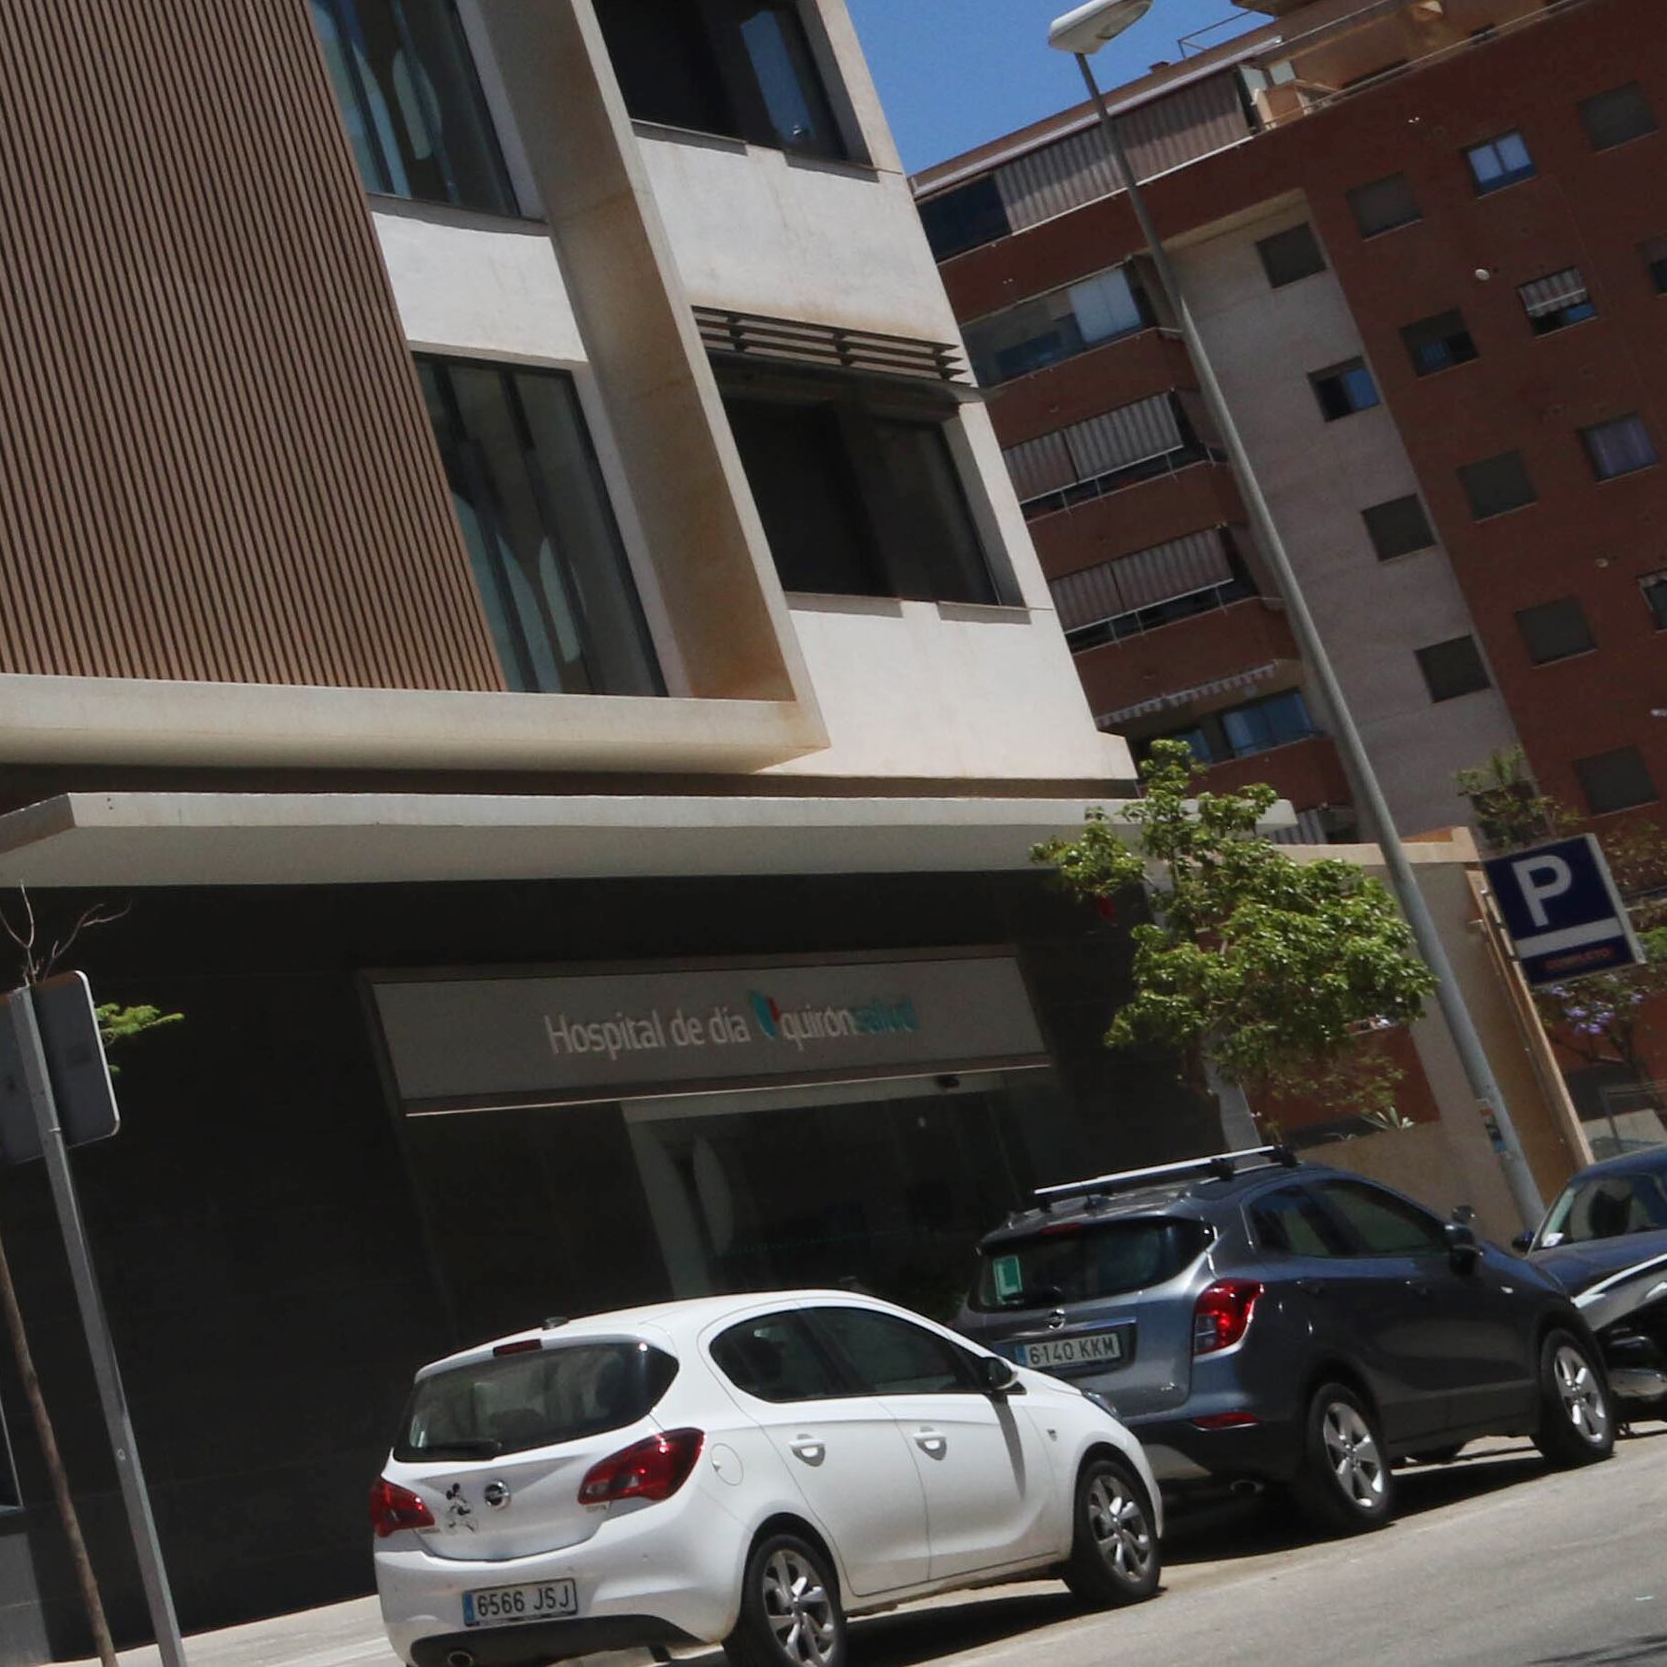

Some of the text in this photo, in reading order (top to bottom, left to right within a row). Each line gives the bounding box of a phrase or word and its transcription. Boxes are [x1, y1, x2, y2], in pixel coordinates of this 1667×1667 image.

[1512, 854, 1571, 925] P
[544, 1008, 666, 1060] Hospital
[670, 1008, 705, 1046] de
[709, 1006, 751, 1044] día
[1029, 1335, 1116, 1364] 6140 KKM
[477, 1586, 570, 1617] 6566 JSJ
